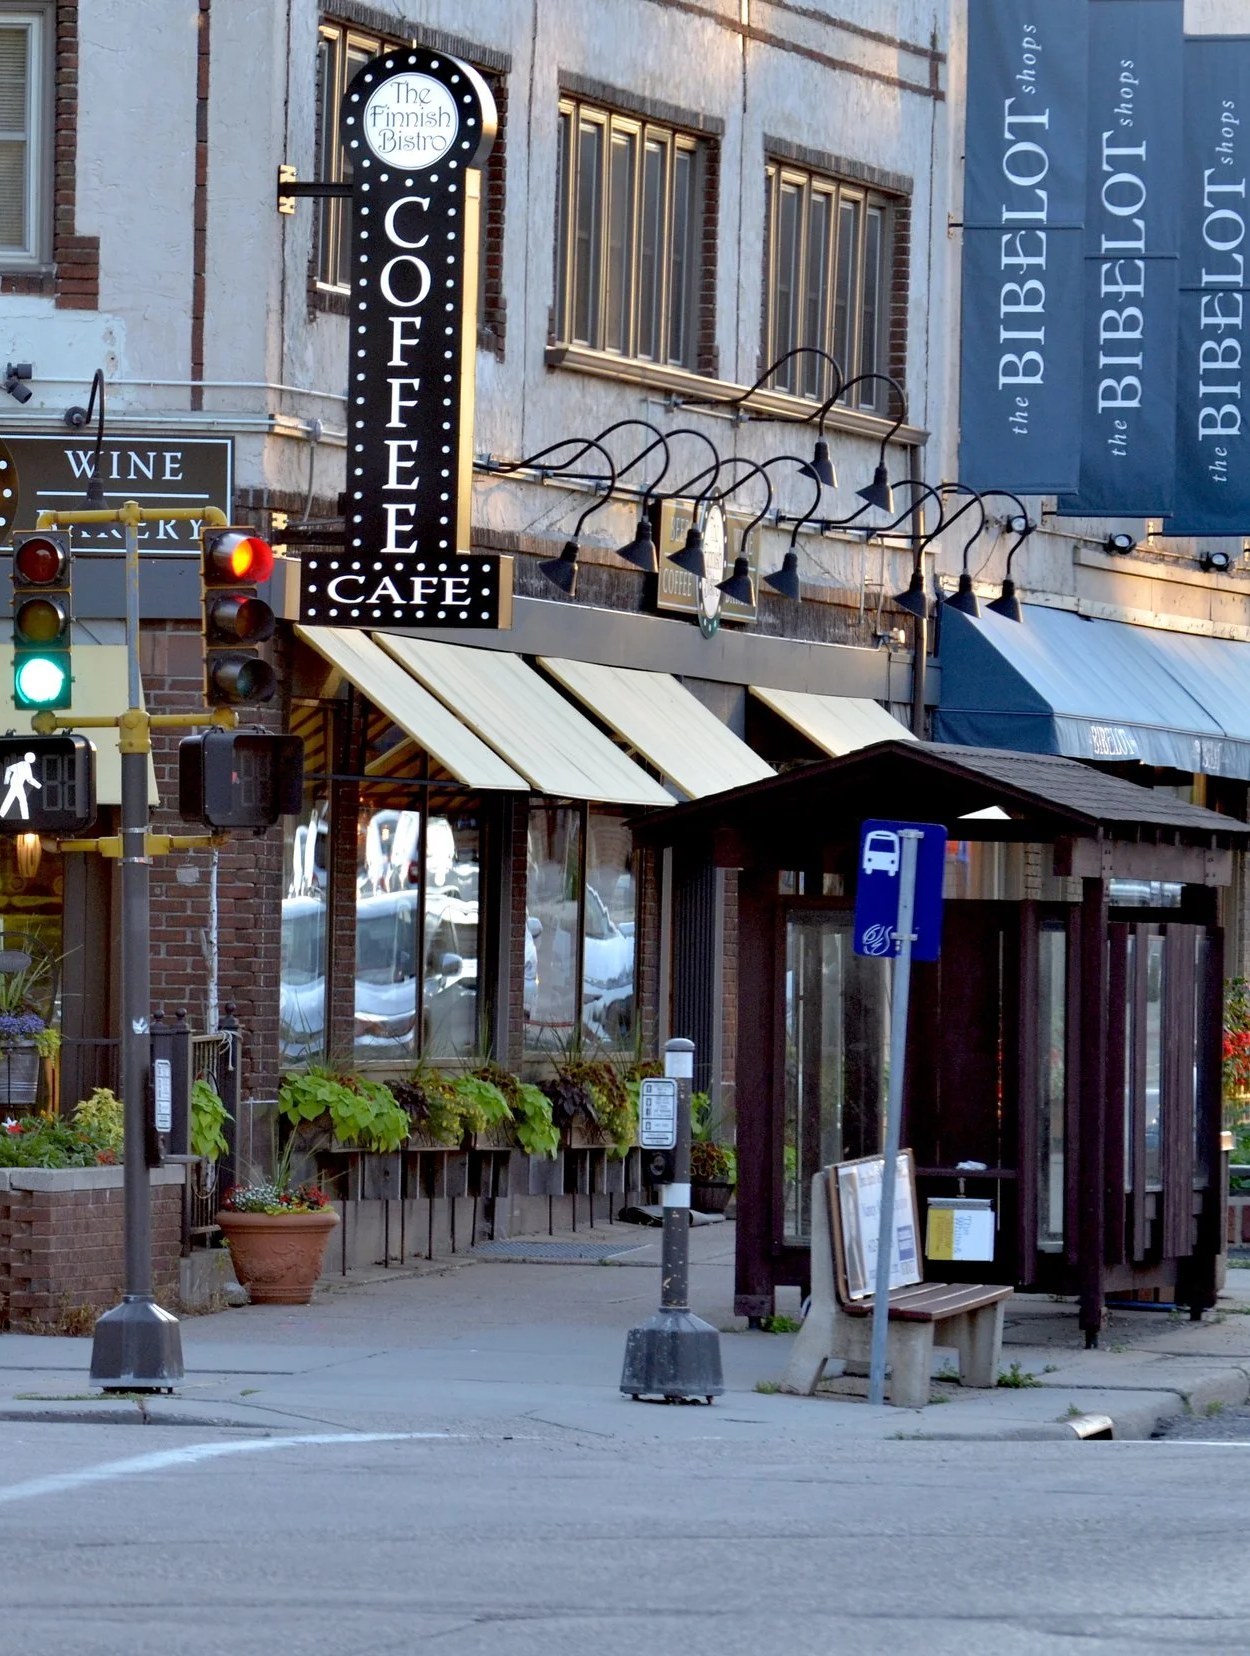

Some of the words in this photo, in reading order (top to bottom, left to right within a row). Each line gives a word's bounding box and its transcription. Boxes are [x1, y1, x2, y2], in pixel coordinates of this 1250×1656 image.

[1016, 24, 1043, 94] shops
[390, 81, 432, 106] The
[1115, 58, 1141, 127] shops
[370, 104, 451, 128] Finnish
[1216, 99, 1241, 165] shops
[378, 129, 447, 153] Bistro
[998, 97, 1050, 390] BIBELOT
[1098, 130, 1147, 414] BIBELOT
[1198, 168, 1246, 441] BIBELOT
[380, 196, 431, 554] COFFEE
[1011, 396, 1029, 435] the
[1110, 419, 1127, 456] the
[65, 450, 183, 480] WINE
[1211, 446, 1227, 483] the
[327, 575, 471, 605] CAFE
